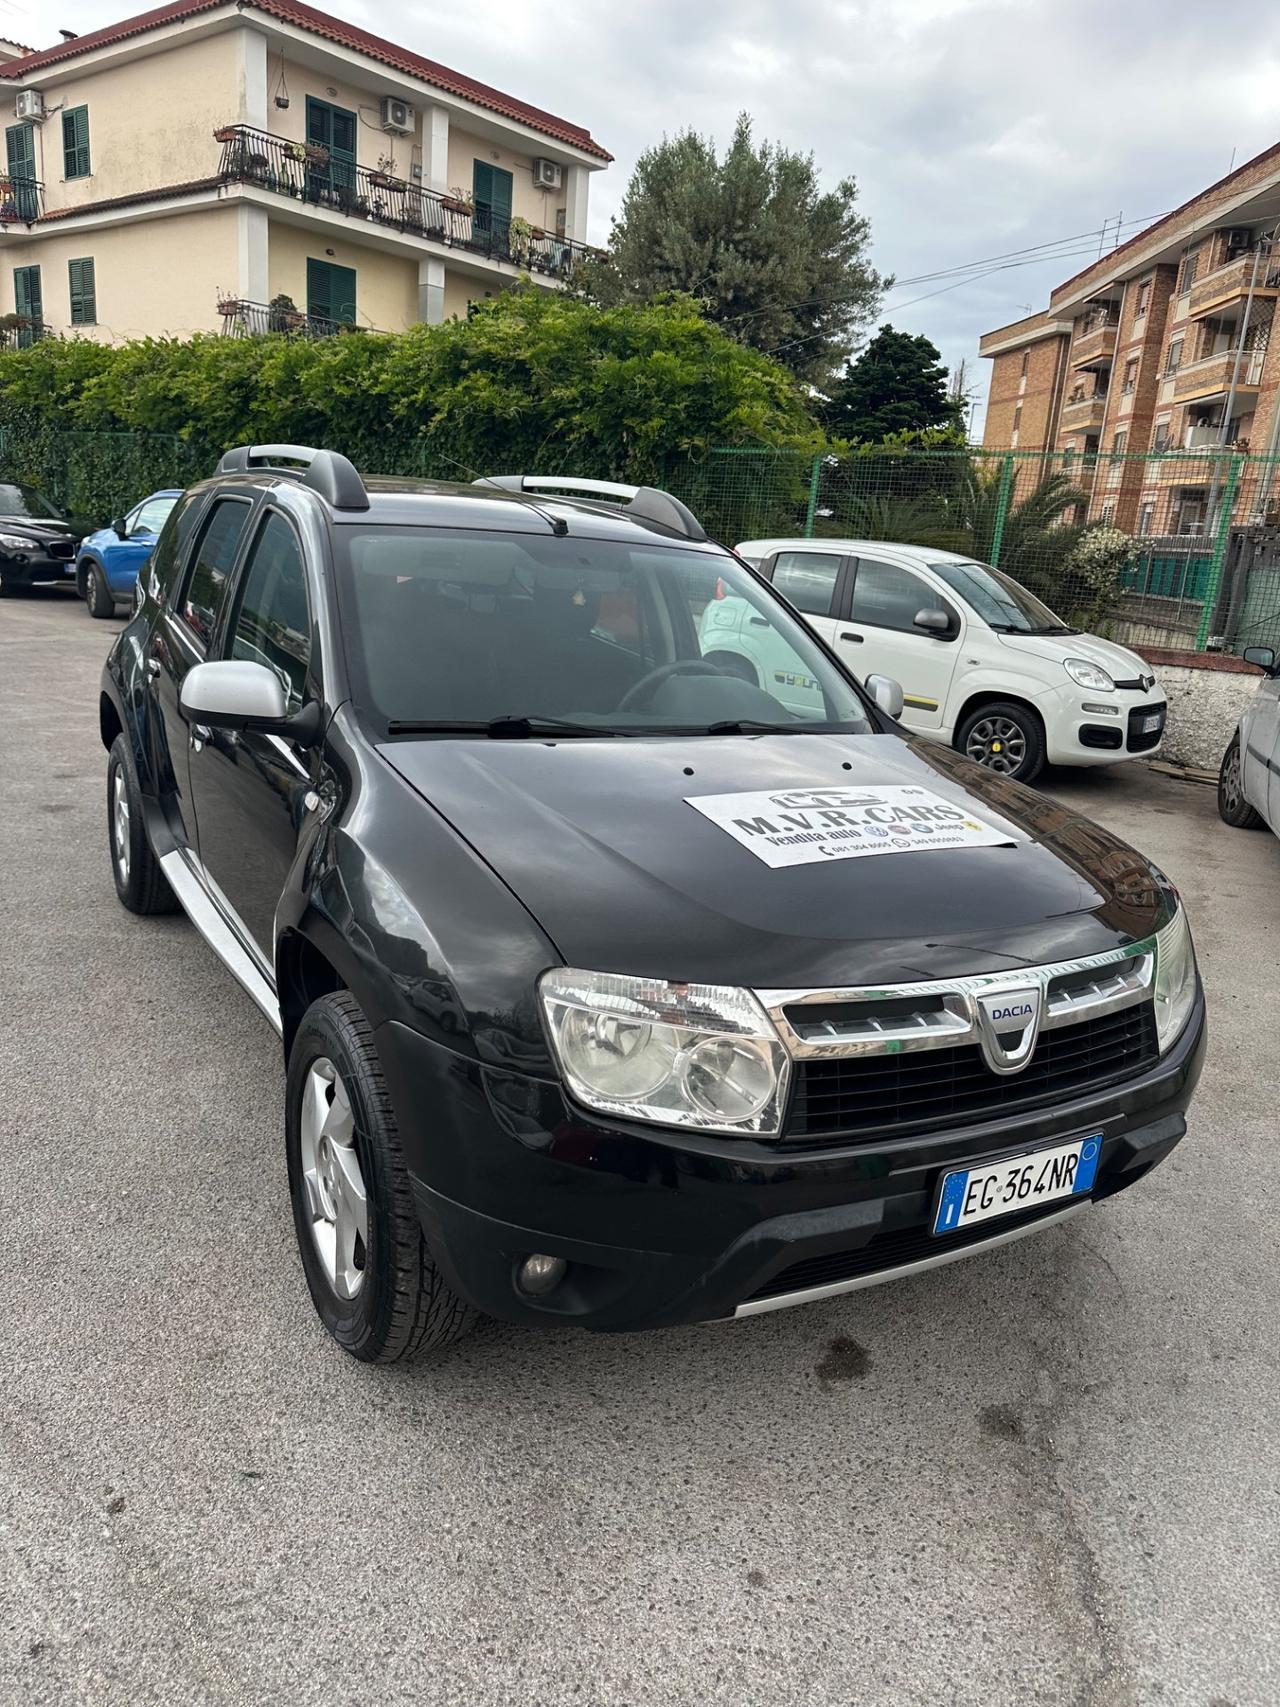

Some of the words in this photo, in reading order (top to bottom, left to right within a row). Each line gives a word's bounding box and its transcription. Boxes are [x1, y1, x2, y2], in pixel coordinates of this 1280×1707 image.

[765, 831, 828, 846] Vendita
[826, 828, 862, 841] auto
[992, 1004, 1033, 1020] DACIA
